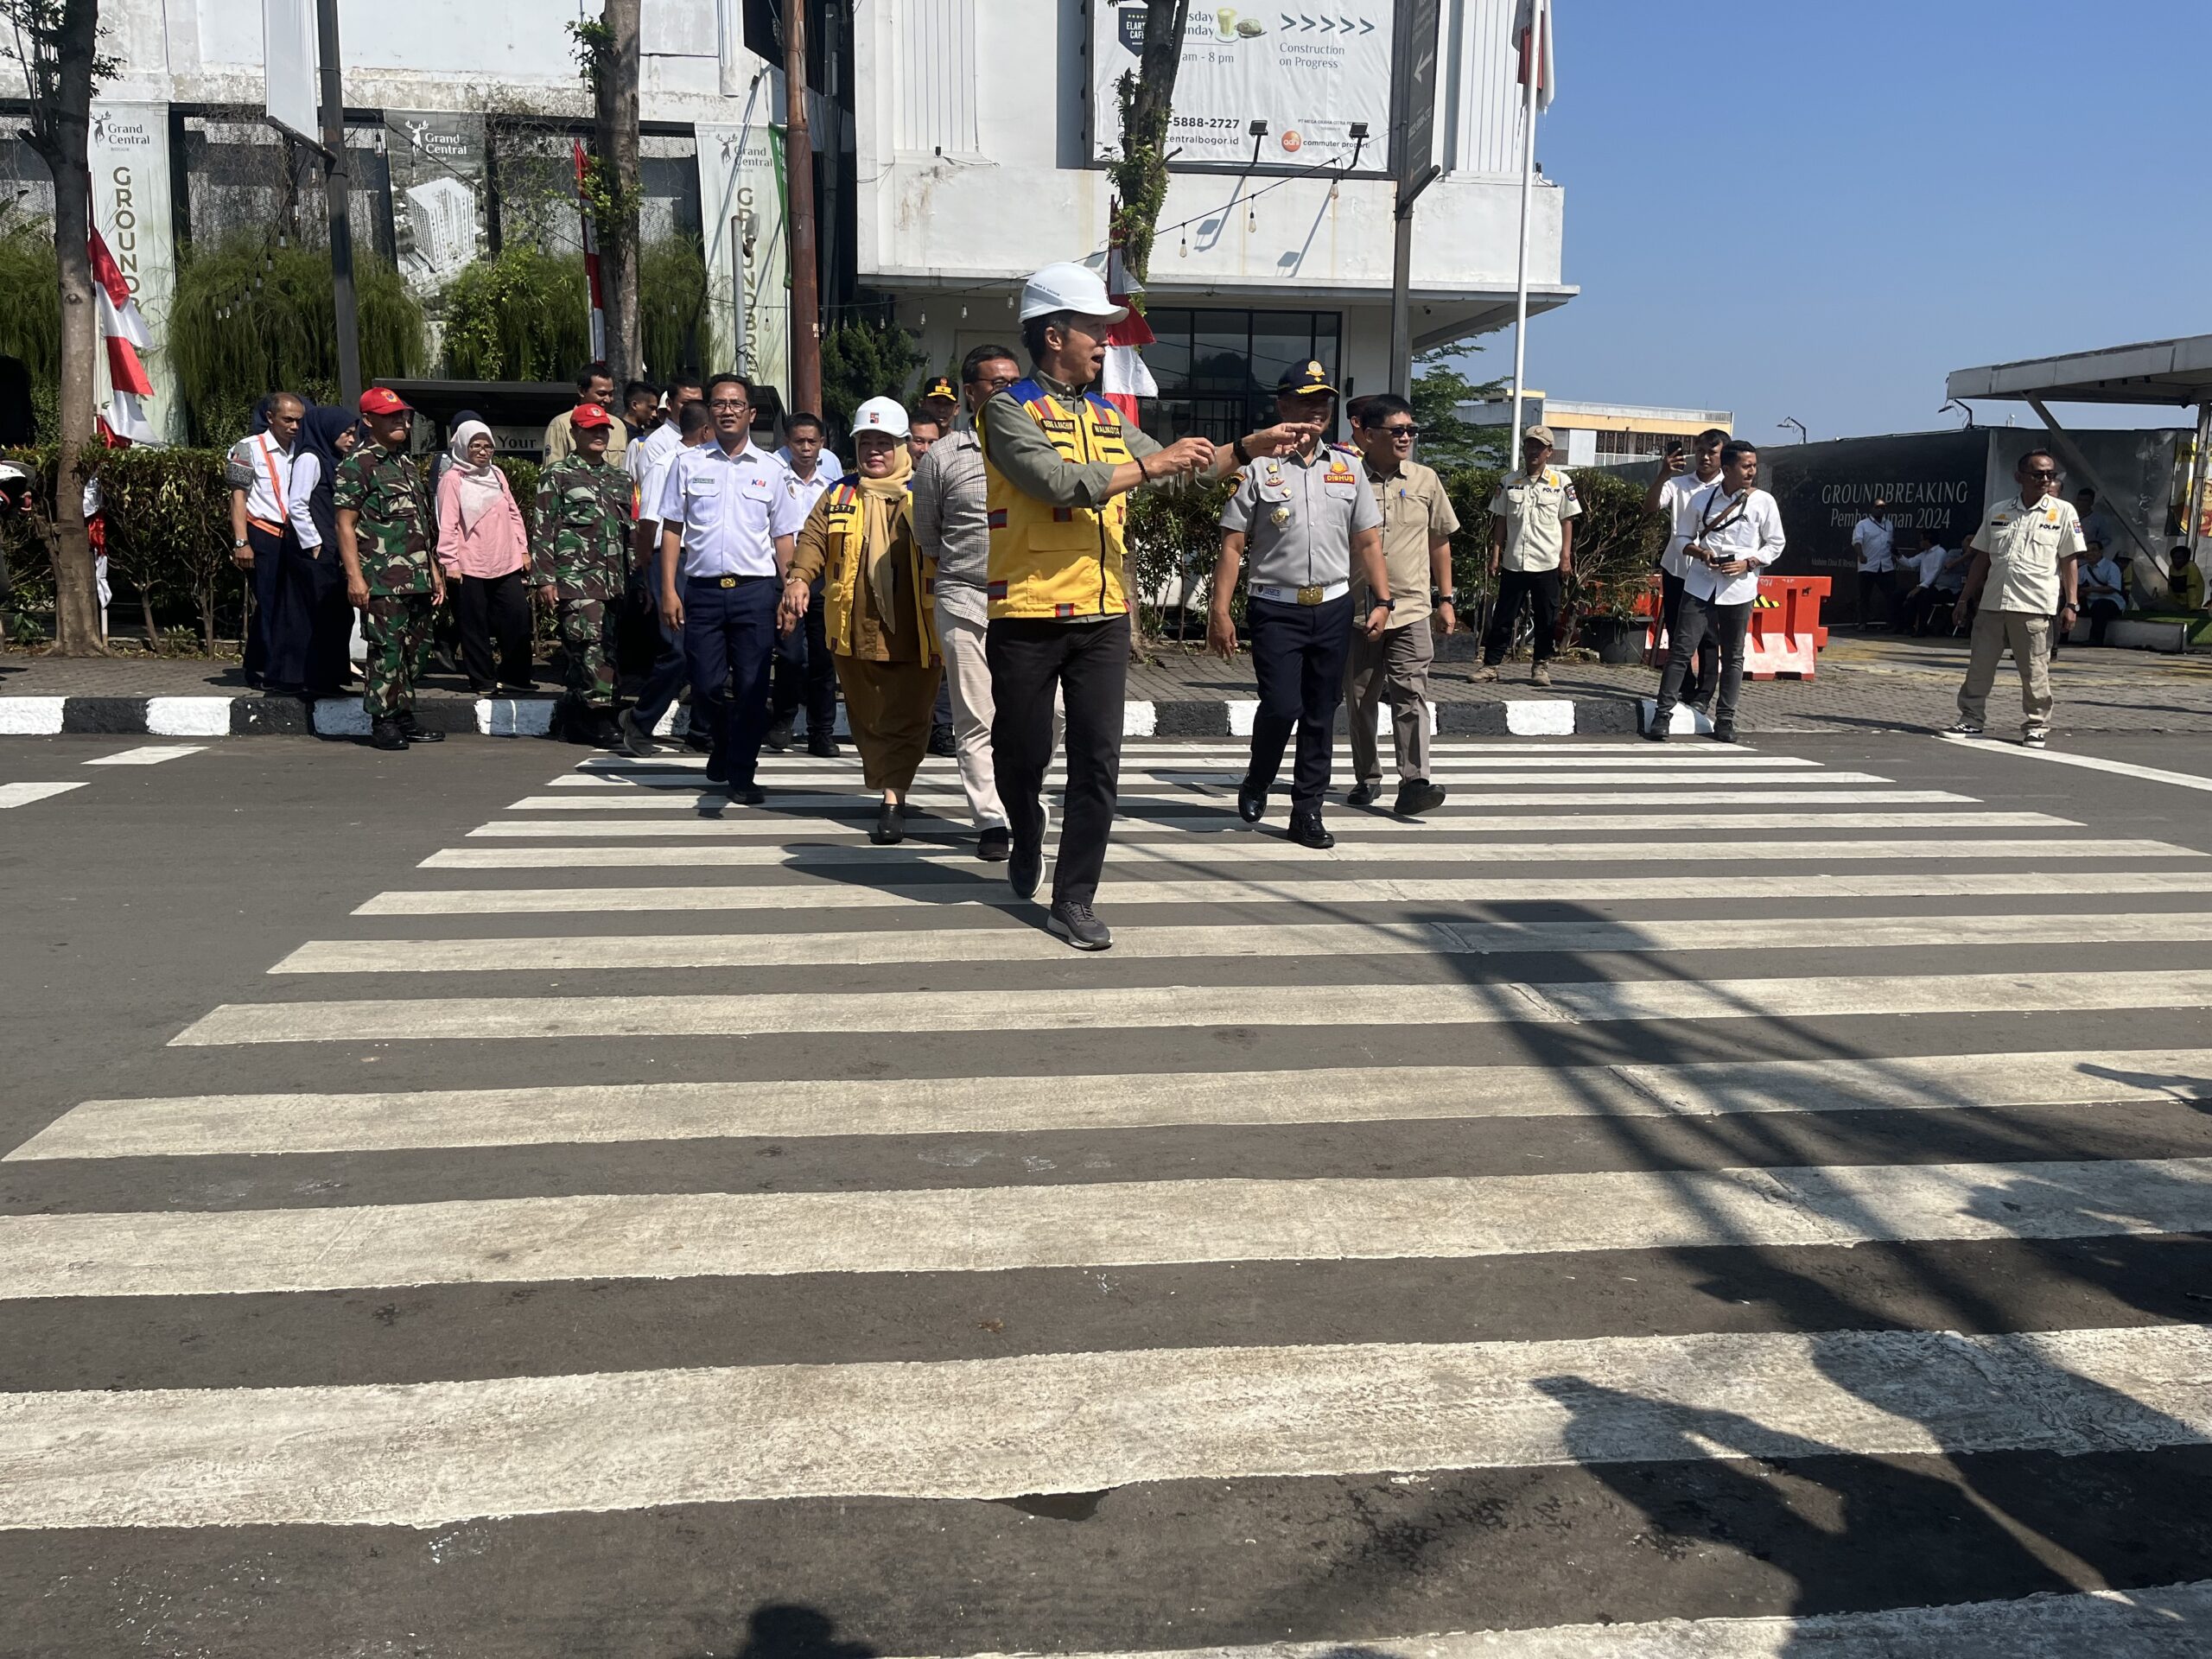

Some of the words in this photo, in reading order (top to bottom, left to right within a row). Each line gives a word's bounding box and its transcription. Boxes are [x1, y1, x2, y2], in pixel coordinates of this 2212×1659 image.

[1186, 11, 1215, 22] sday
[1280, 42, 1344, 55] Construction
[1182, 53, 1198, 61] am
[1209, 52, 1215, 63] 8
[1218, 54, 1234, 65] pm
[1279, 58, 1292, 67] on
[1295, 56, 1338, 69] Progress
[108, 124, 143, 134] Grand
[1167, 117, 1240, 129] -5888-2727
[109, 135, 150, 144] Central
[424, 132, 461, 144] Grand
[1165, 135, 1239, 146] centralbogor.id
[1303, 139, 1339, 148] commuter
[426, 143, 467, 155] Central
[734, 146, 767, 156] Grand
[735, 156, 773, 167] Central
[1094, 426, 1121, 435] WALIKOTA
[497, 435, 537, 448] Your
[1821, 480, 1968, 505] GROUNDBREAKING
[1916, 507, 1950, 529] 2024
